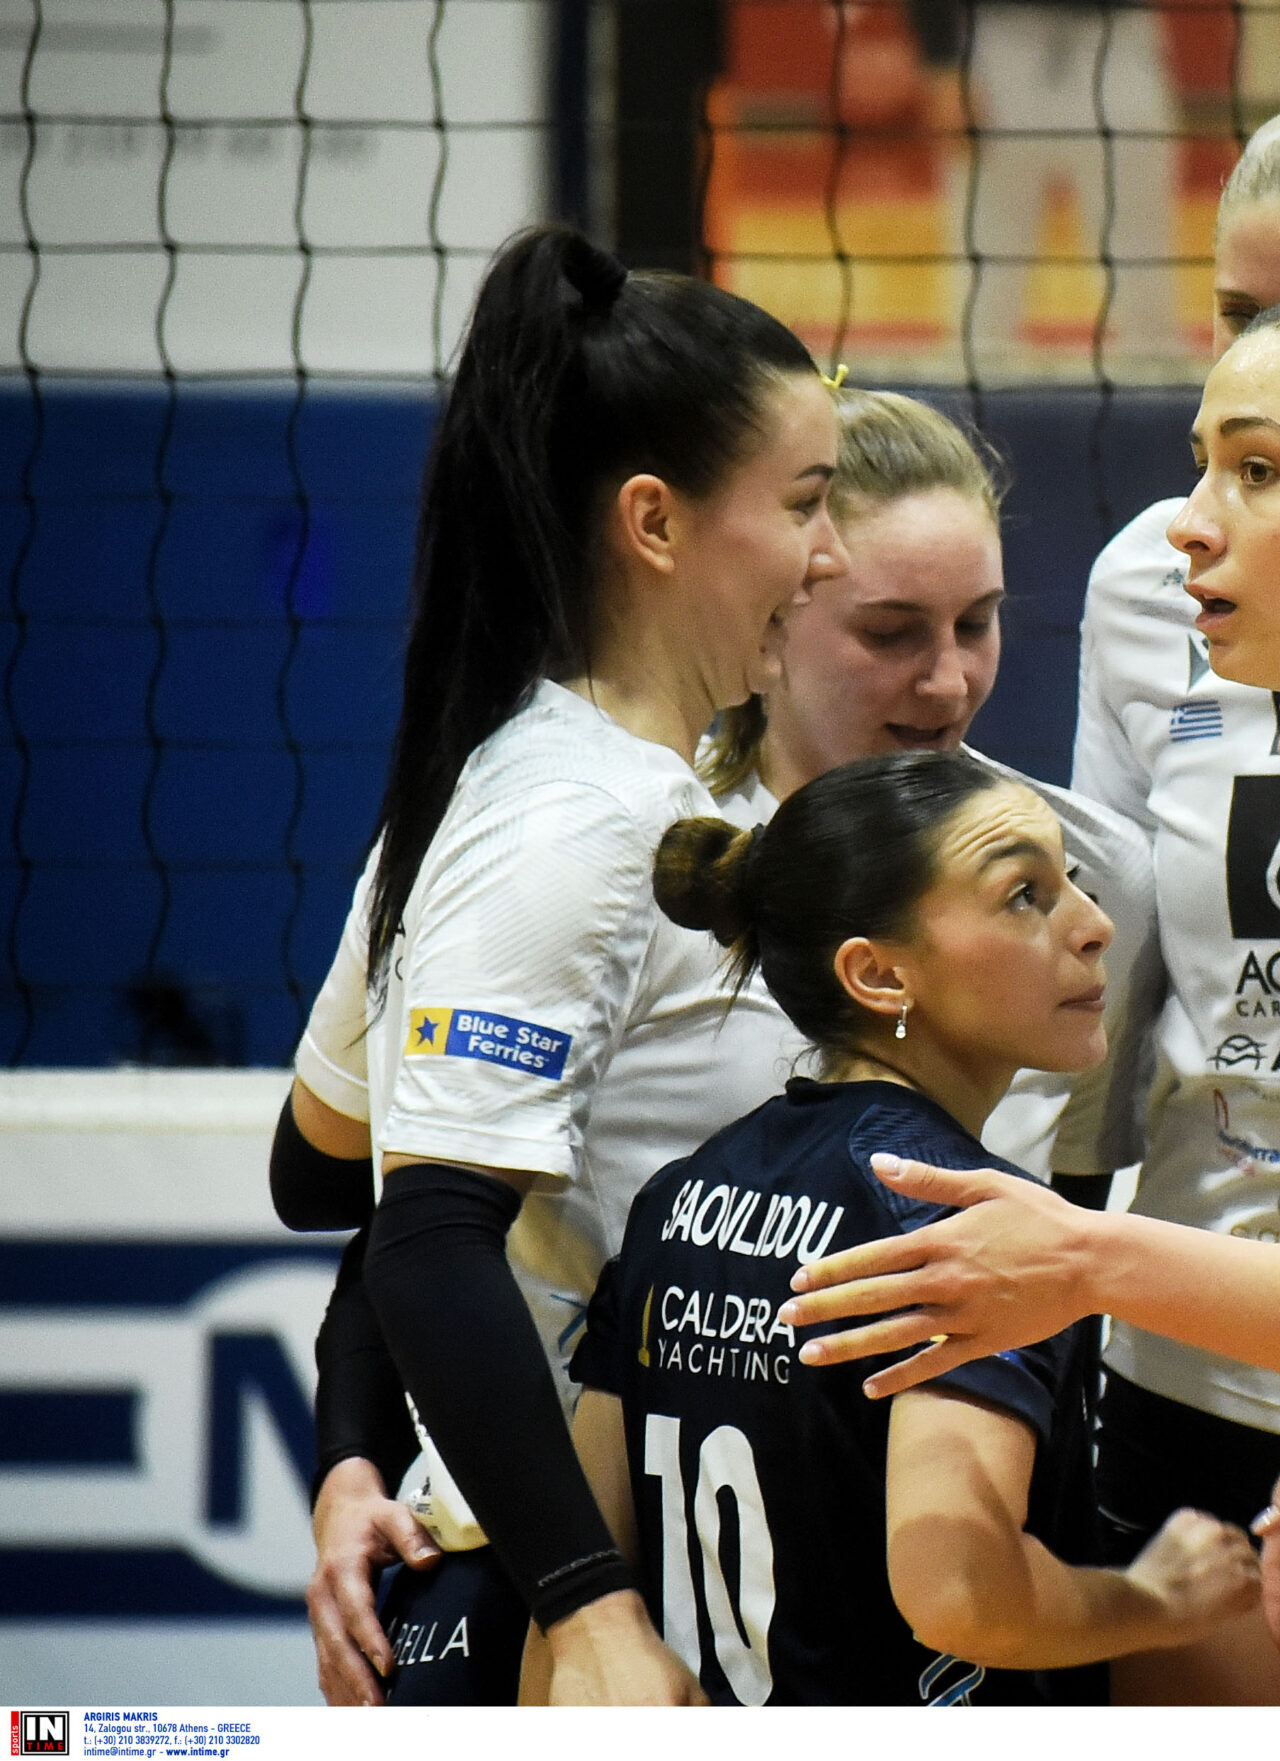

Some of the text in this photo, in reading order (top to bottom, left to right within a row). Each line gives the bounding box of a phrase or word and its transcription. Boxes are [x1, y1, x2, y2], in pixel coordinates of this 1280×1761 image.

[457, 1015, 562, 1053] Blue Star
[468, 1035, 545, 1069] Ferries
[662, 1286, 795, 1348] CALDERA
[658, 1338, 790, 1384] YACHTING
[645, 1413, 776, 1706] 10
